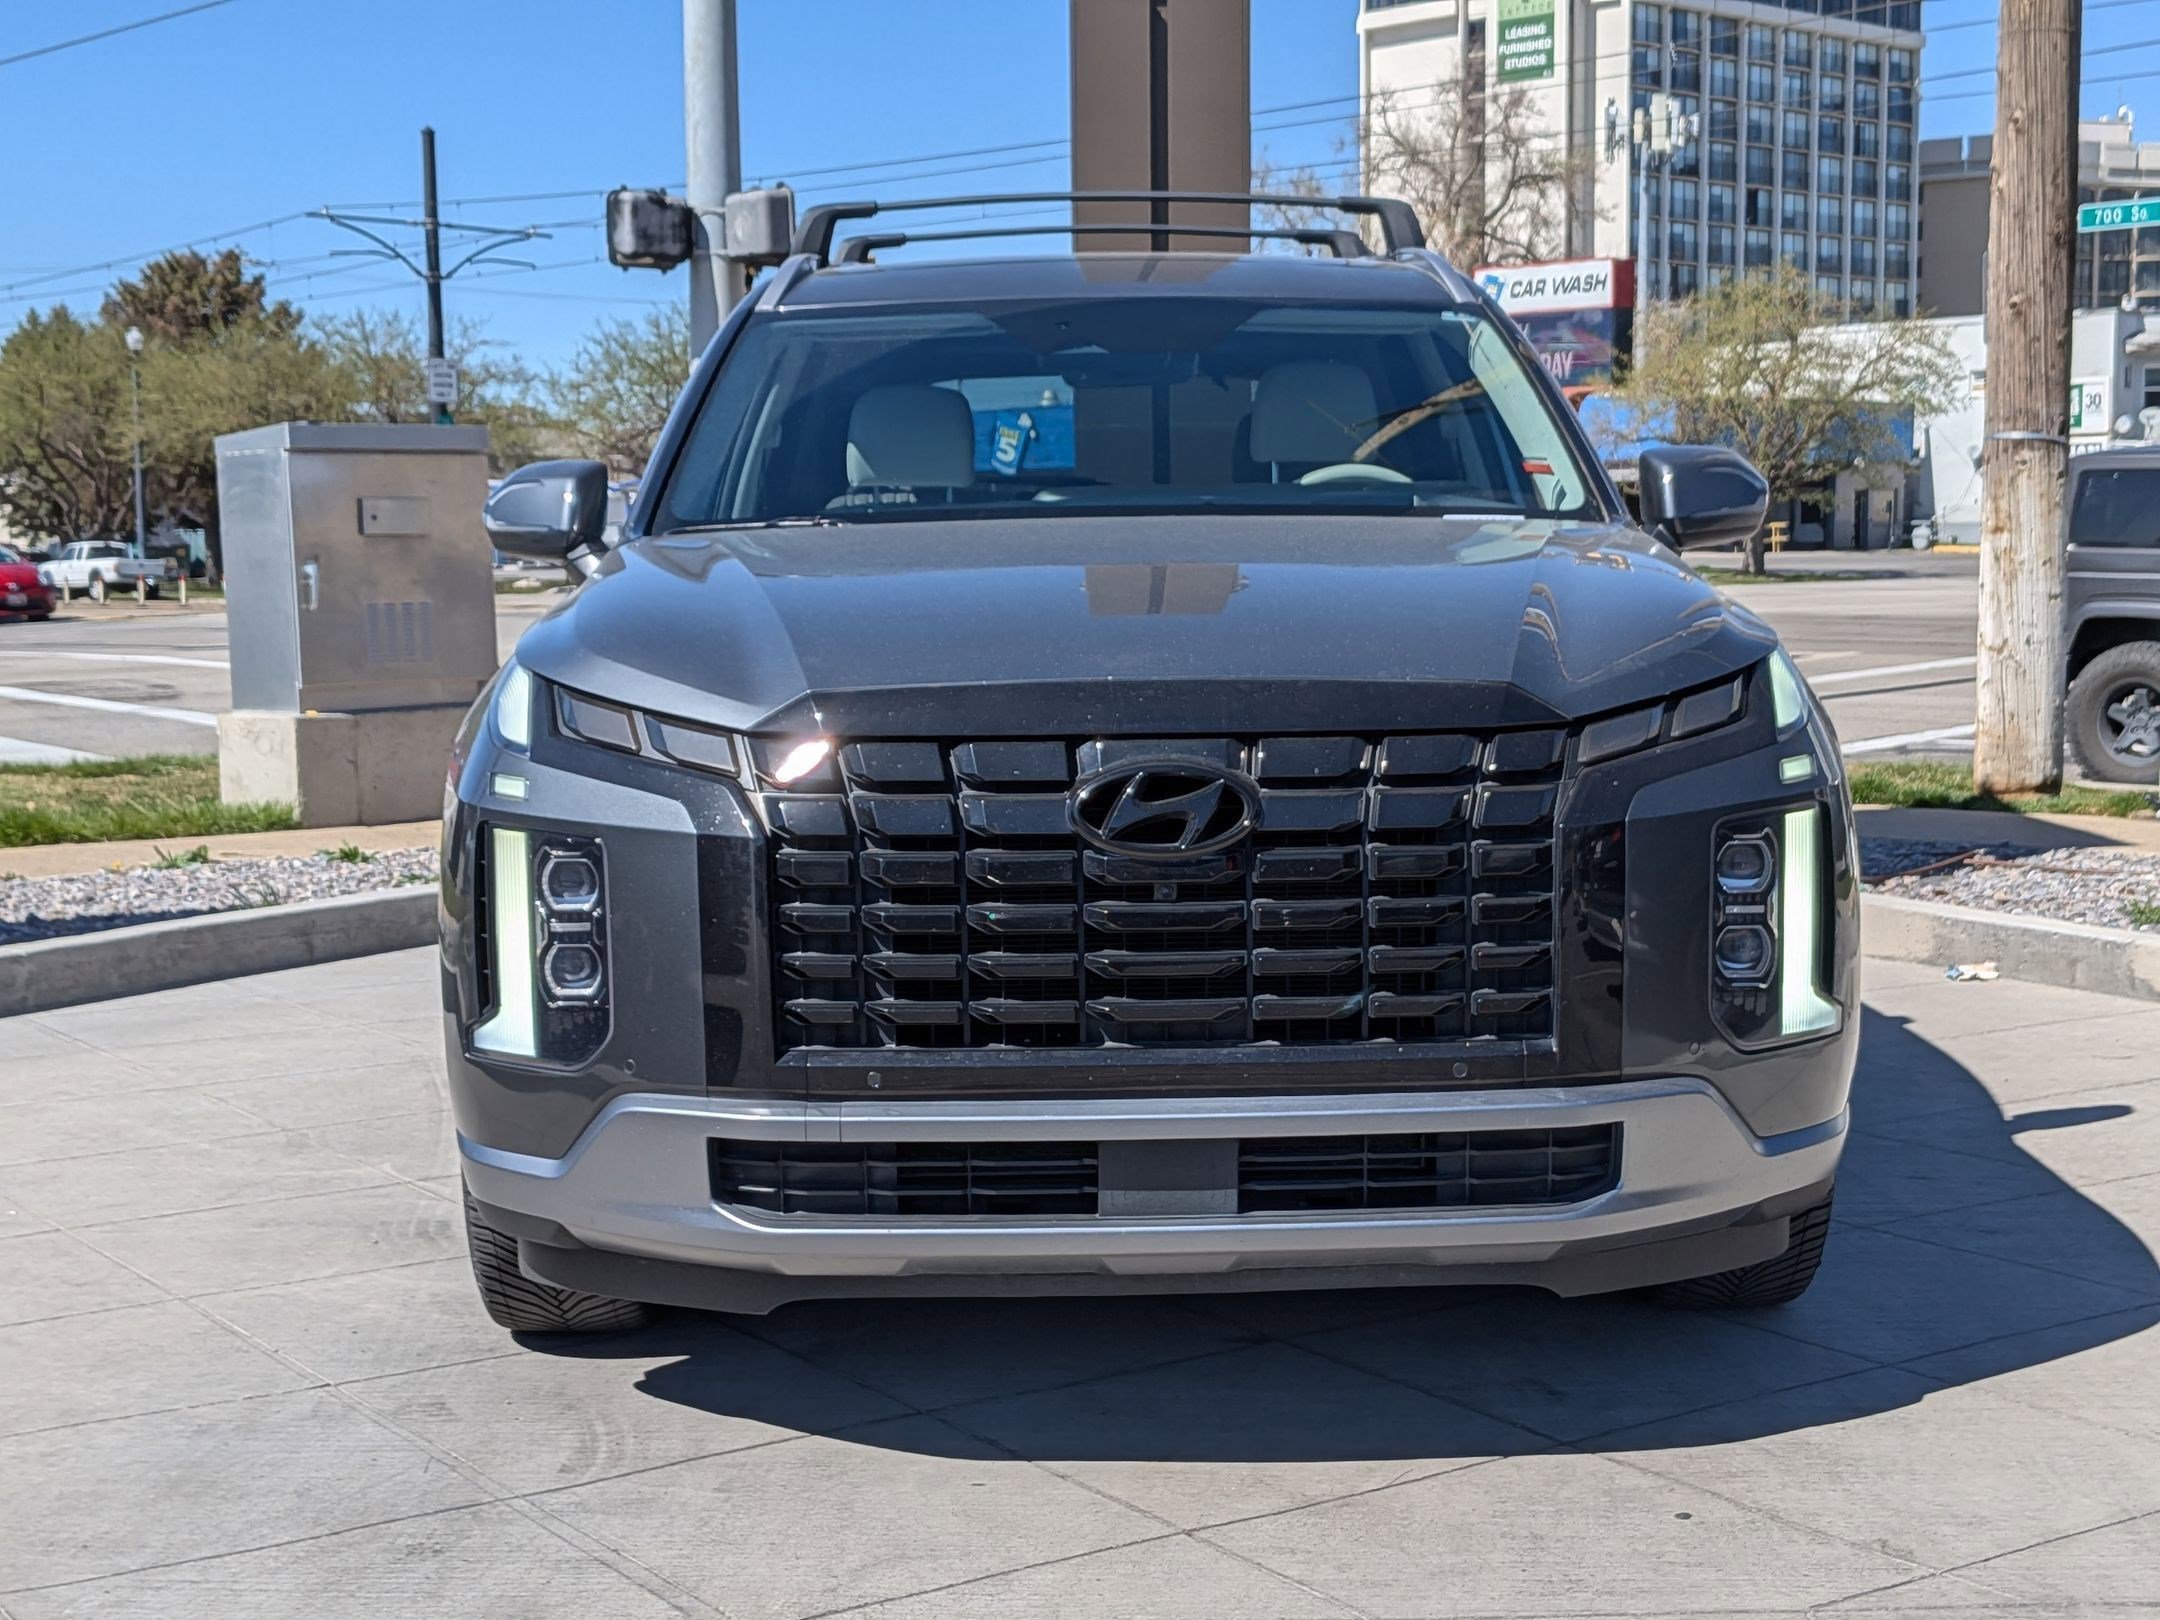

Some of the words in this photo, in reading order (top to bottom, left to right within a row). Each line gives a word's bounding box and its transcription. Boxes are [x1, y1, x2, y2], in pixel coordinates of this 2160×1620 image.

[1504, 21, 1547, 40] LEASING
[1498, 36, 1552, 56] FURNISHED
[1504, 53, 1547, 71] STUDIOS
[2094, 207, 2122, 225] 700
[2131, 205, 2148, 221] So
[1510, 279, 1546, 299] CAR
[1552, 272, 1608, 296] WASH
